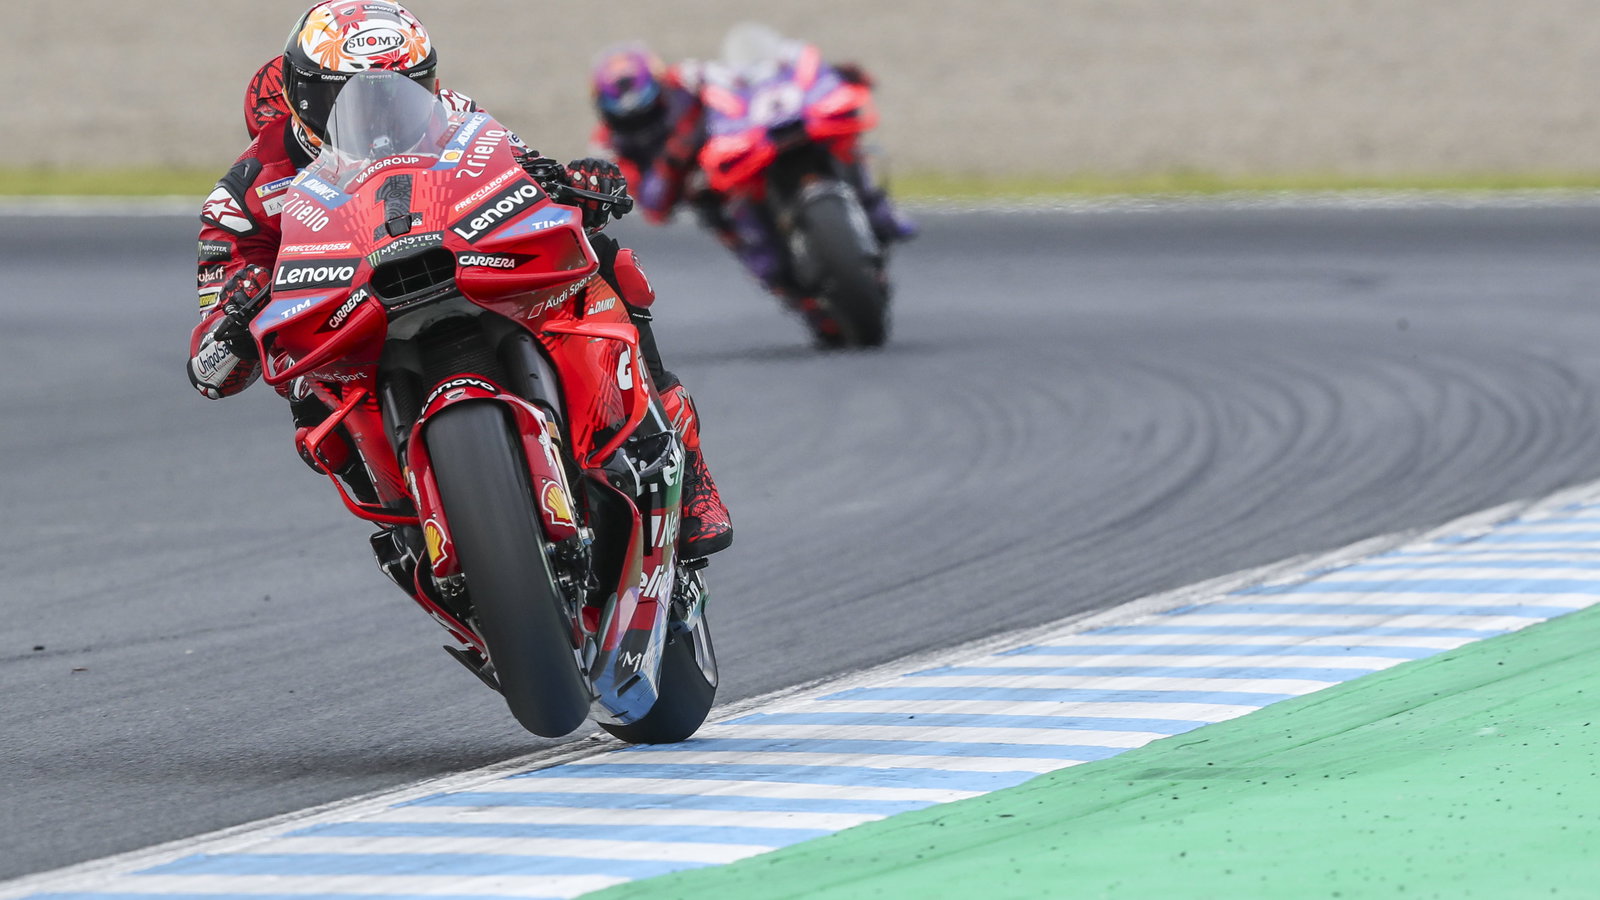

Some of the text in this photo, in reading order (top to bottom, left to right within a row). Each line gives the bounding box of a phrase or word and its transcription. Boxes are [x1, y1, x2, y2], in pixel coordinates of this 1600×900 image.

[347, 36, 401, 49] SUOMY
[455, 114, 487, 147] ADVANCE
[355, 155, 420, 184] VARGROUP
[301, 178, 340, 201] ADVANCE
[454, 166, 521, 213] FRECCIAROSSA
[453, 183, 539, 241] Lenovo
[531, 217, 565, 231] TIM
[281, 242, 352, 253] FRECCIAROSSA
[381, 233, 442, 256] MONSTER
[458, 255, 516, 269] CARRERA
[274, 265, 355, 286] Lenovo
[280, 298, 312, 319] TIM
[328, 288, 368, 329] CARRERA
[544, 289, 568, 311] Audi
